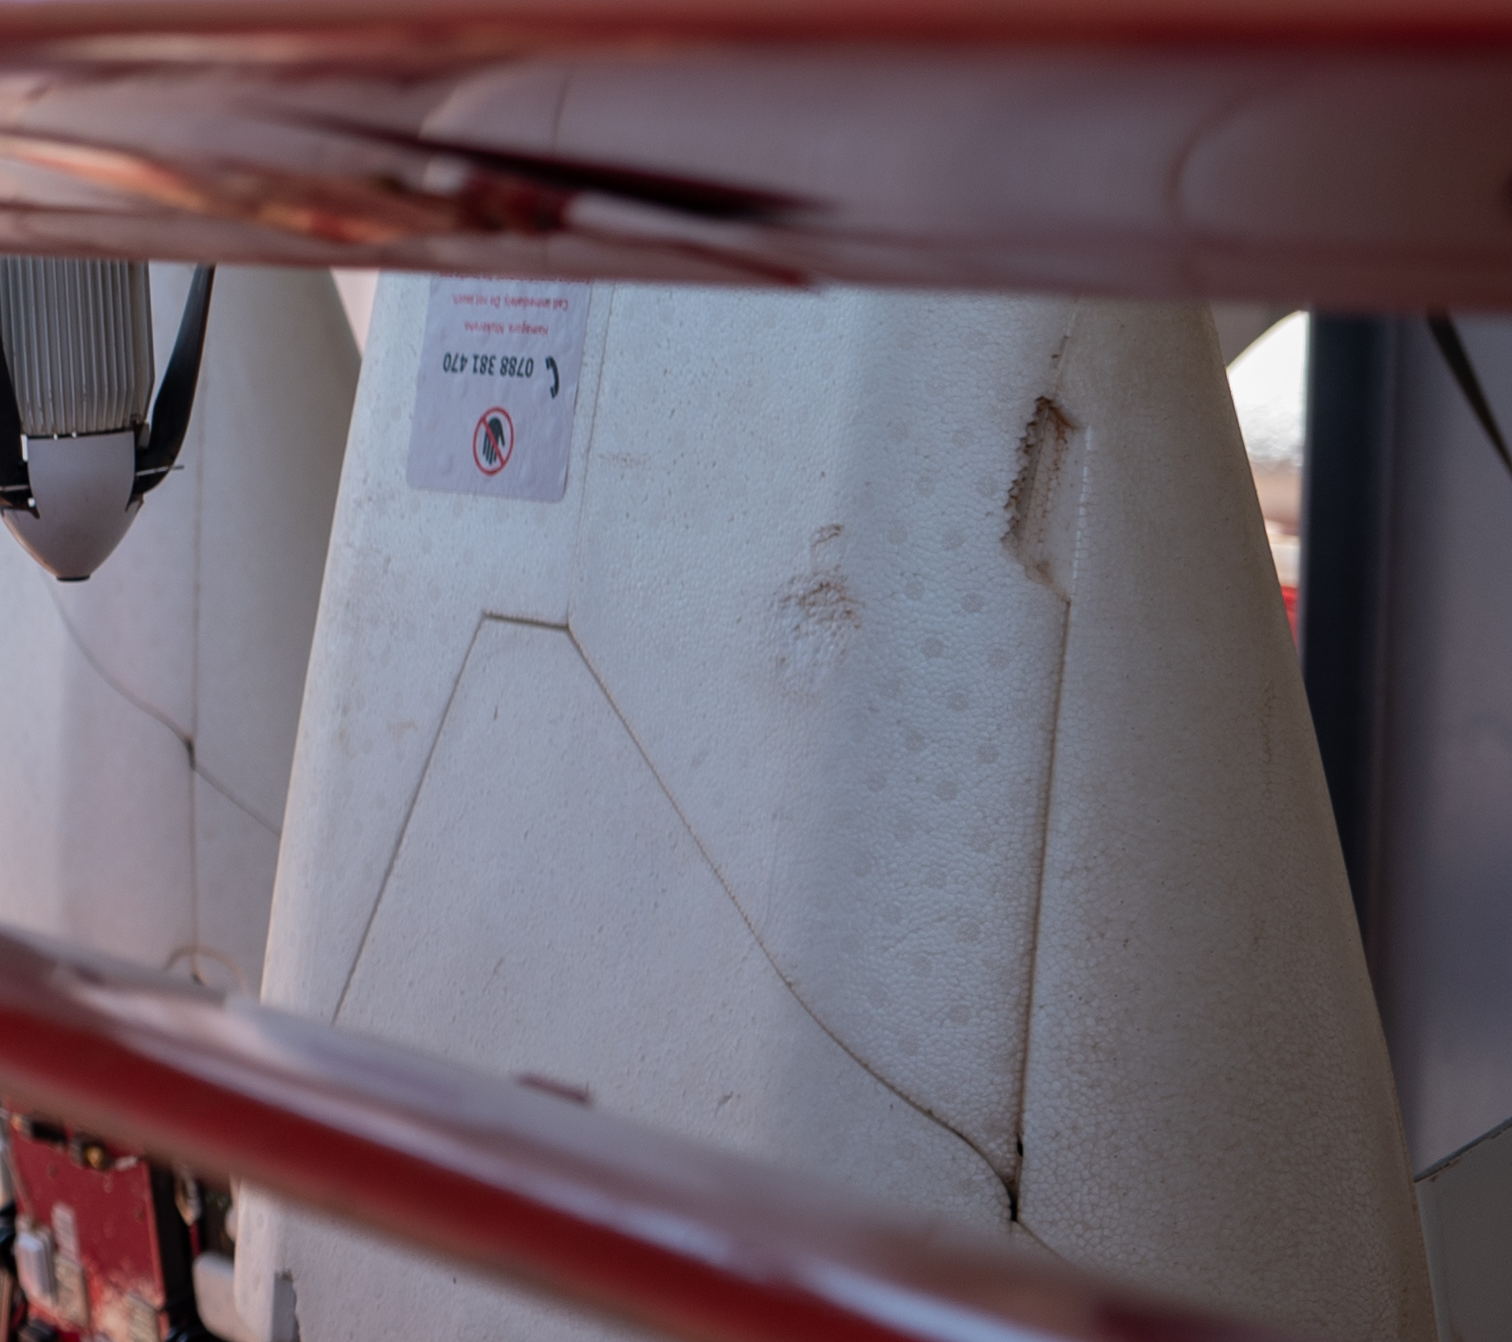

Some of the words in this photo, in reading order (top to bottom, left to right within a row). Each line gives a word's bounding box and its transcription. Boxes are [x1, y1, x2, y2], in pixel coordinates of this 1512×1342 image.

[442, 351, 468, 373] 470
[472, 353, 498, 376] 381
[500, 355, 535, 378] 0788
